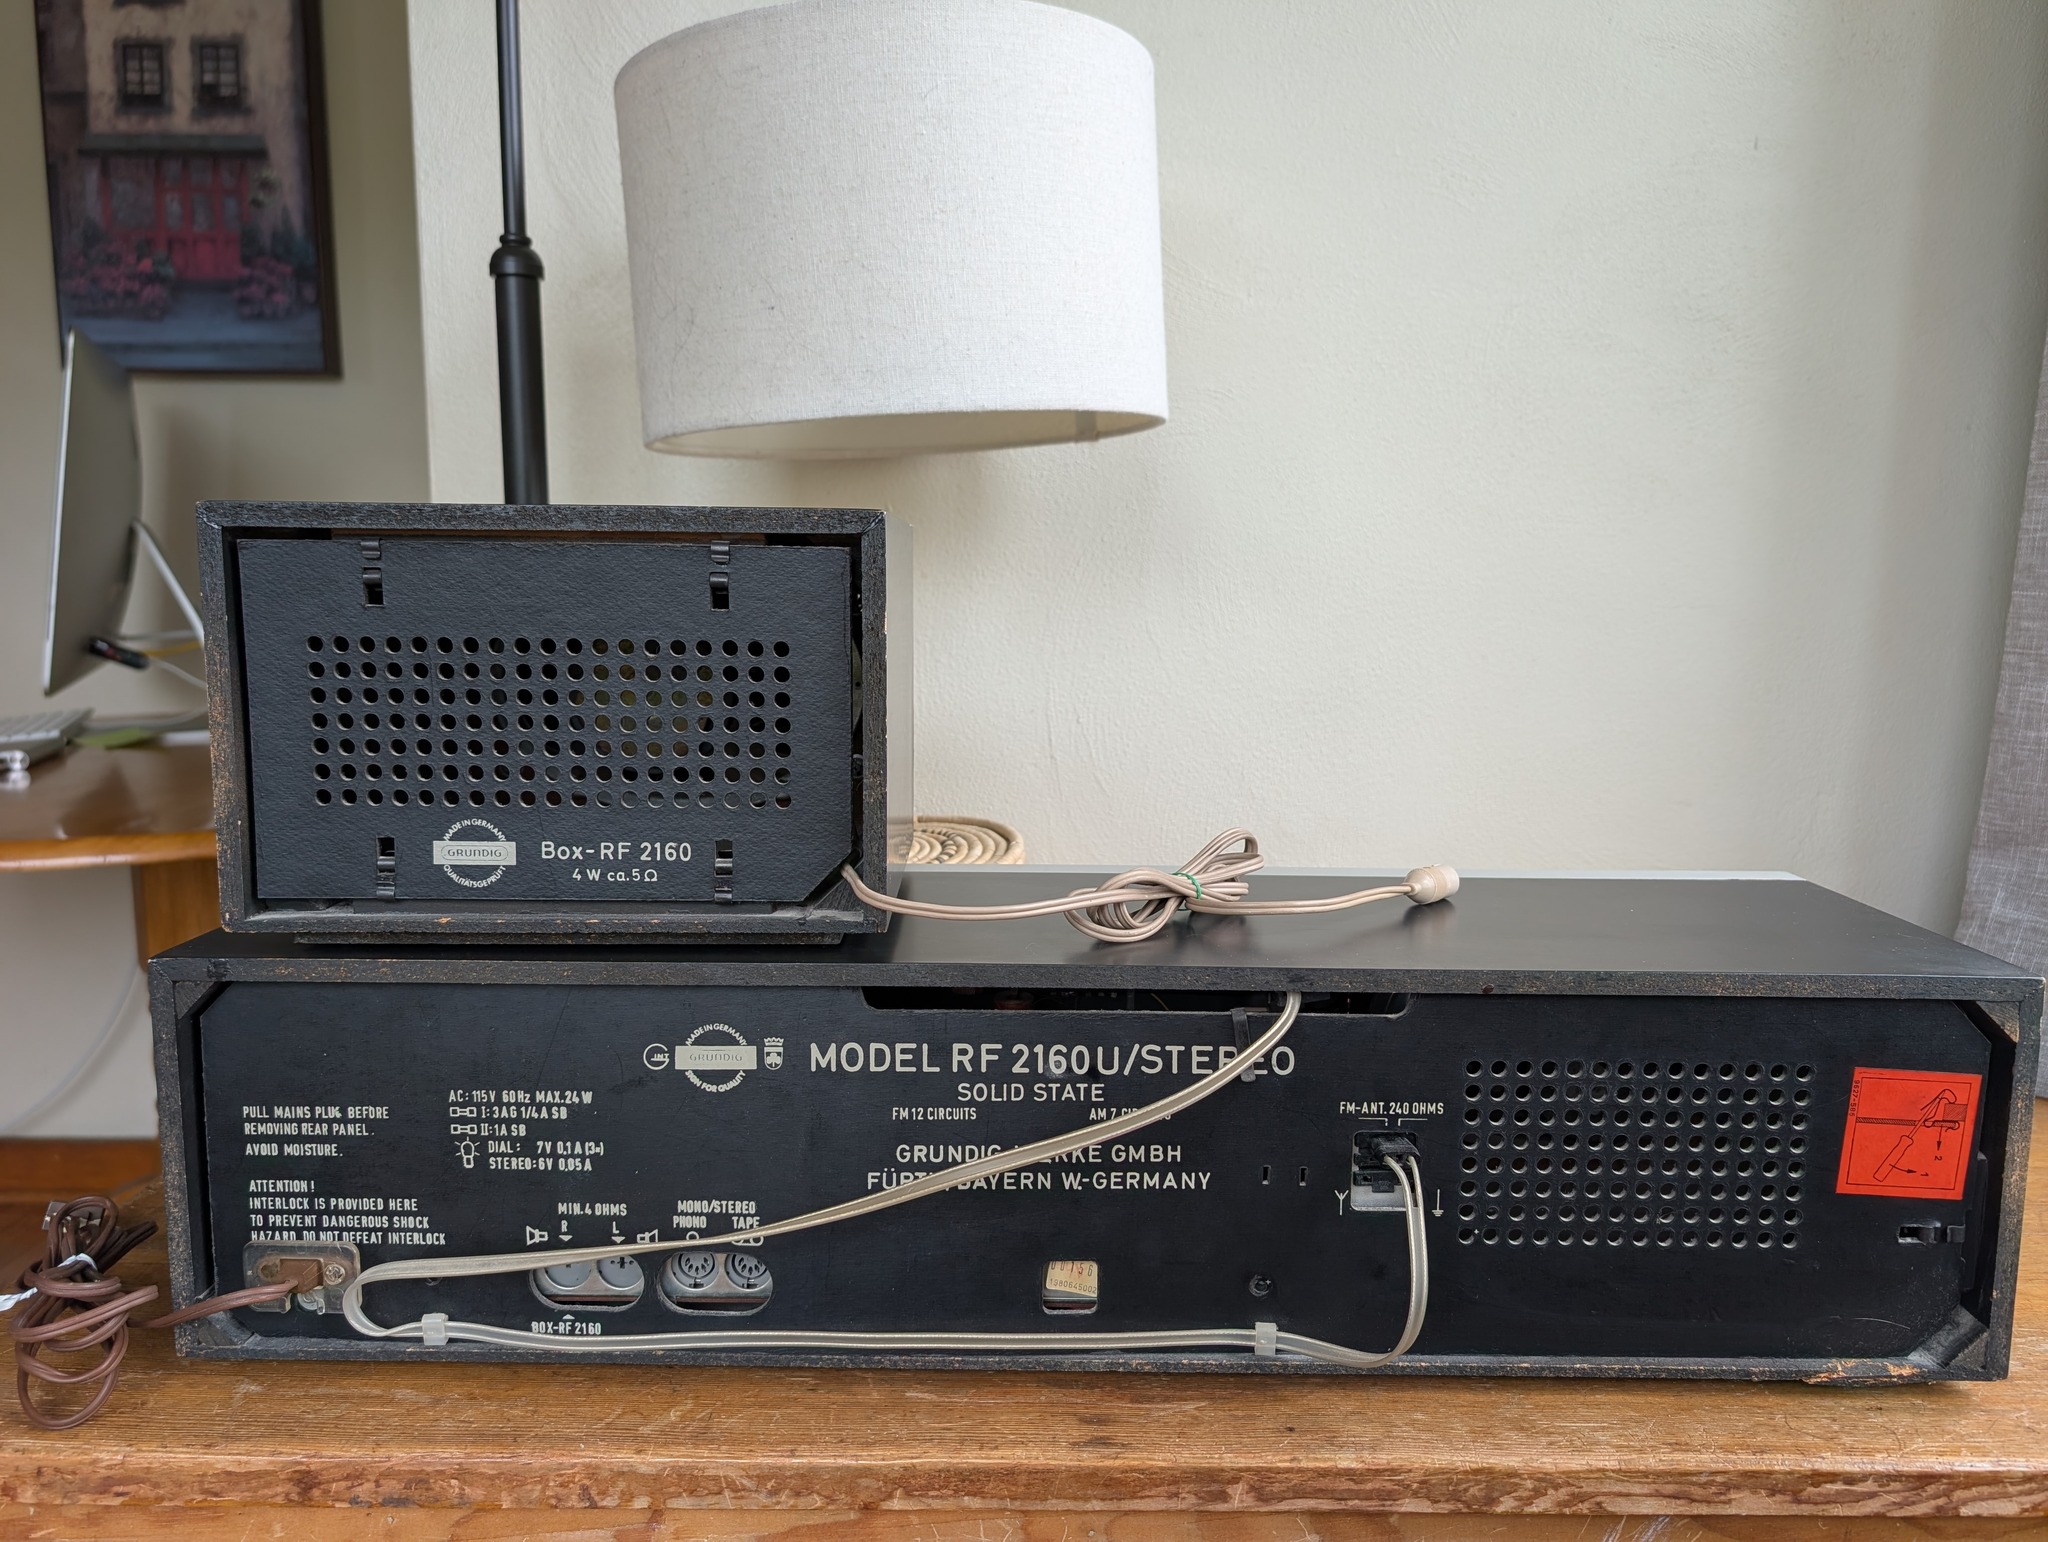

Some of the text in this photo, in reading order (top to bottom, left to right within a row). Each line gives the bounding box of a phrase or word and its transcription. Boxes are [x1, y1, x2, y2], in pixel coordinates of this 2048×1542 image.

[471, 818, 507, 841] GERMANY
[447, 848, 502, 858] GRUNDIG
[542, 841, 691, 861] Box-RF 2160
[573, 868, 581, 880] 4
[587, 869, 600, 881] W
[712, 1023, 748, 1046] GERMANY
[689, 1052, 743, 1062] GRUNDIG
[808, 1040, 942, 1074] MODEL
[950, 1041, 1004, 1074] RF
[449, 1090, 468, 1102] AC:
[958, 1083, 1104, 1101] SOLID STATE
[243, 1106, 389, 1118] PULL MAINS PLUG BEFORE
[893, 1108, 976, 1120] FM 12 CIRCUITS
[1089, 1107, 1107, 1121] AM
[1110, 1107, 1117, 1120] 7
[1389, 1102, 1409, 1114] 240
[1413, 1102, 1443, 1114] OHMS
[244, 1121, 376, 1137] REMOVING REAR PANEL.
[246, 1143, 342, 1156] AVOID MOISTURE.
[1110, 1143, 1183, 1164] GMBH
[250, 1197, 417, 1210] INTERLOCK IS PROVIDED HERE
[595, 1203, 627, 1216] OHMS
[678, 1200, 755, 1214] MONO/STEREO
[250, 1215, 429, 1228] TO PREVENT DANGEROUS SHOCK
[562, 1220, 619, 1233] R L
[672, 1215, 761, 1230] PHONO TAPE
[251, 1231, 446, 1245] HAZARD DO NOT DEFEAT INTERLOCK
[530, 1322, 601, 1335] BOX-RF 2160
